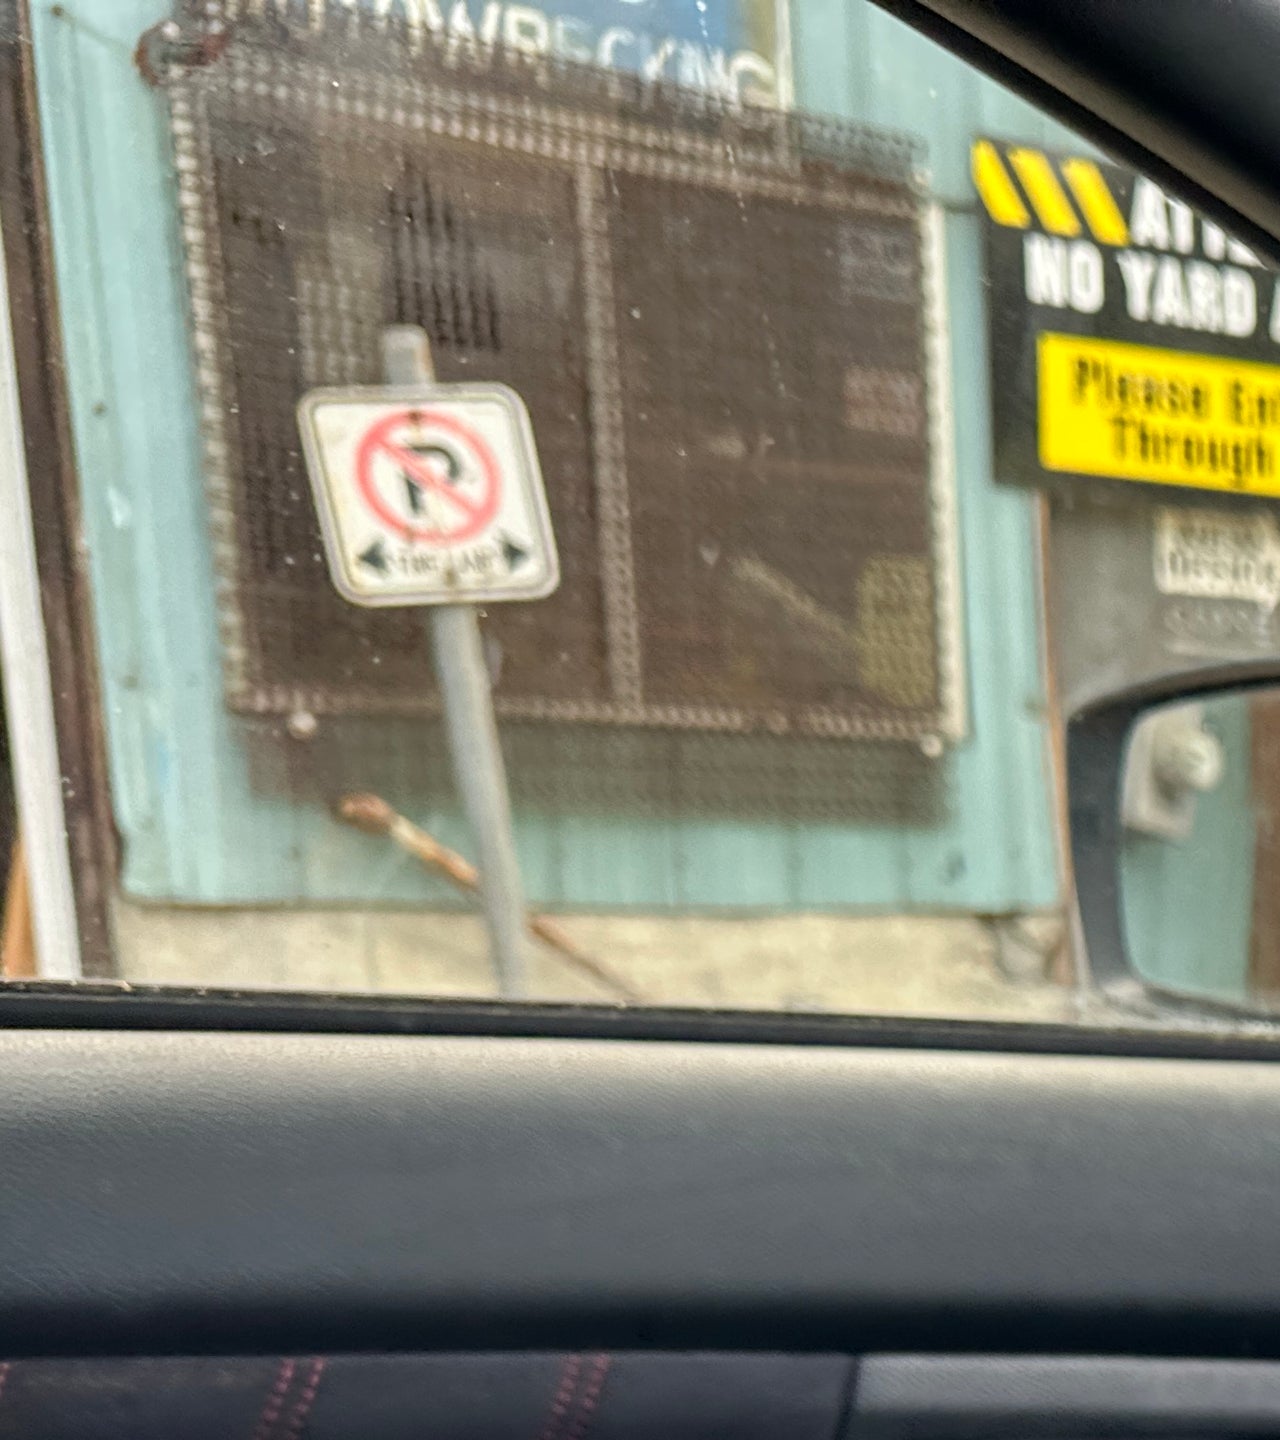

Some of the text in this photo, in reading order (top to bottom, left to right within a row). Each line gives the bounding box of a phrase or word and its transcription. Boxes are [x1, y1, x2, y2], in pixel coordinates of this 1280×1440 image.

[1023, 231, 1104, 314] NO
[1116, 250, 1257, 338] YARD
[1074, 356, 1209, 420] Please
[1108, 417, 1276, 489] Through
